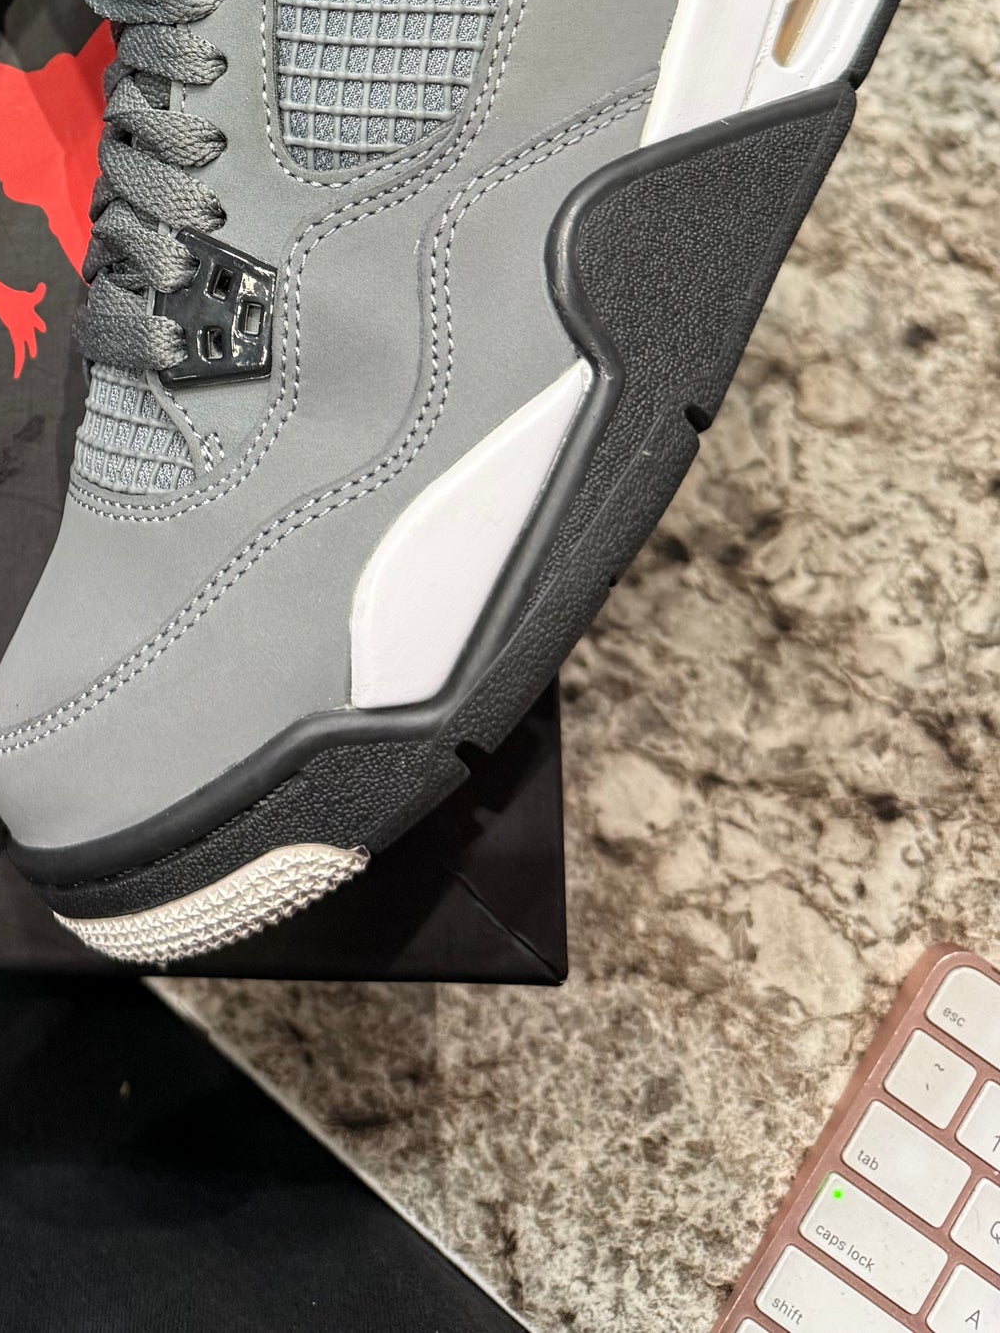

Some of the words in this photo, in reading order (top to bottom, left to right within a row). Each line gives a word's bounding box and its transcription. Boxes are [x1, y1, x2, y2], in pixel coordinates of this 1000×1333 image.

[943, 1007, 966, 1027] esc
[857, 1150, 879, 1171] tab
[815, 1224, 845, 1251] caps
[847, 1245, 875, 1272] lock
[771, 1297, 804, 1325] shift
[965, 1309, 981, 1330] A
